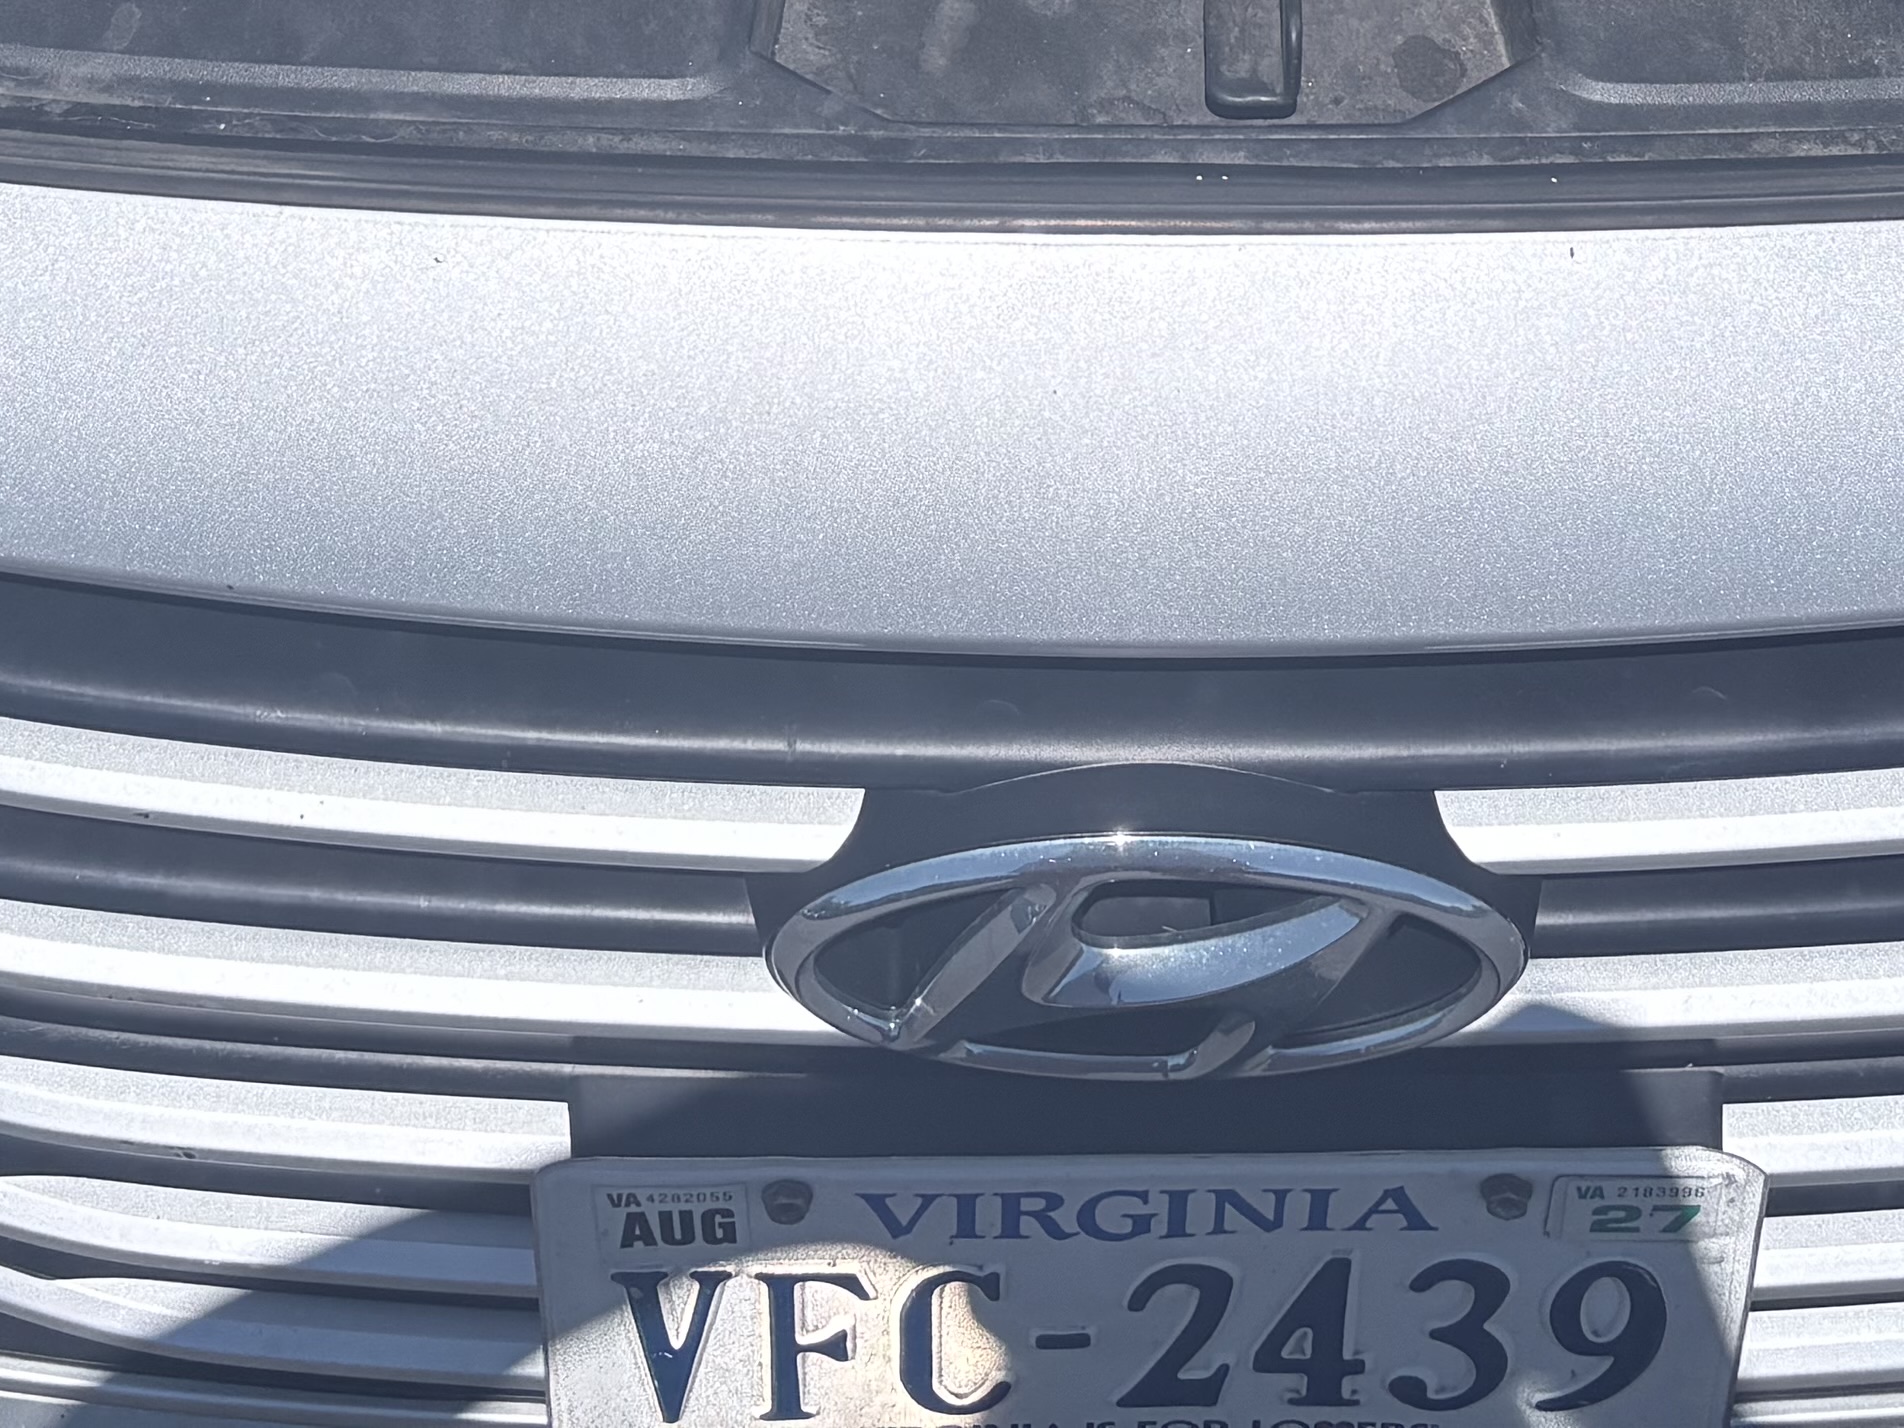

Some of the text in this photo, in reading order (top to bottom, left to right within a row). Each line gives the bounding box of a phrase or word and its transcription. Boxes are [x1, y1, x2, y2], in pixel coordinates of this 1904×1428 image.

[606, 1191, 642, 1208] VA
[1576, 1184, 1605, 1200] VA
[619, 1207, 738, 1249] AUG
[855, 1186, 1439, 1242] VIRGINIA
[1589, 1204, 1702, 1234] 27
[609, 1256, 1670, 1424] VFC-2439
